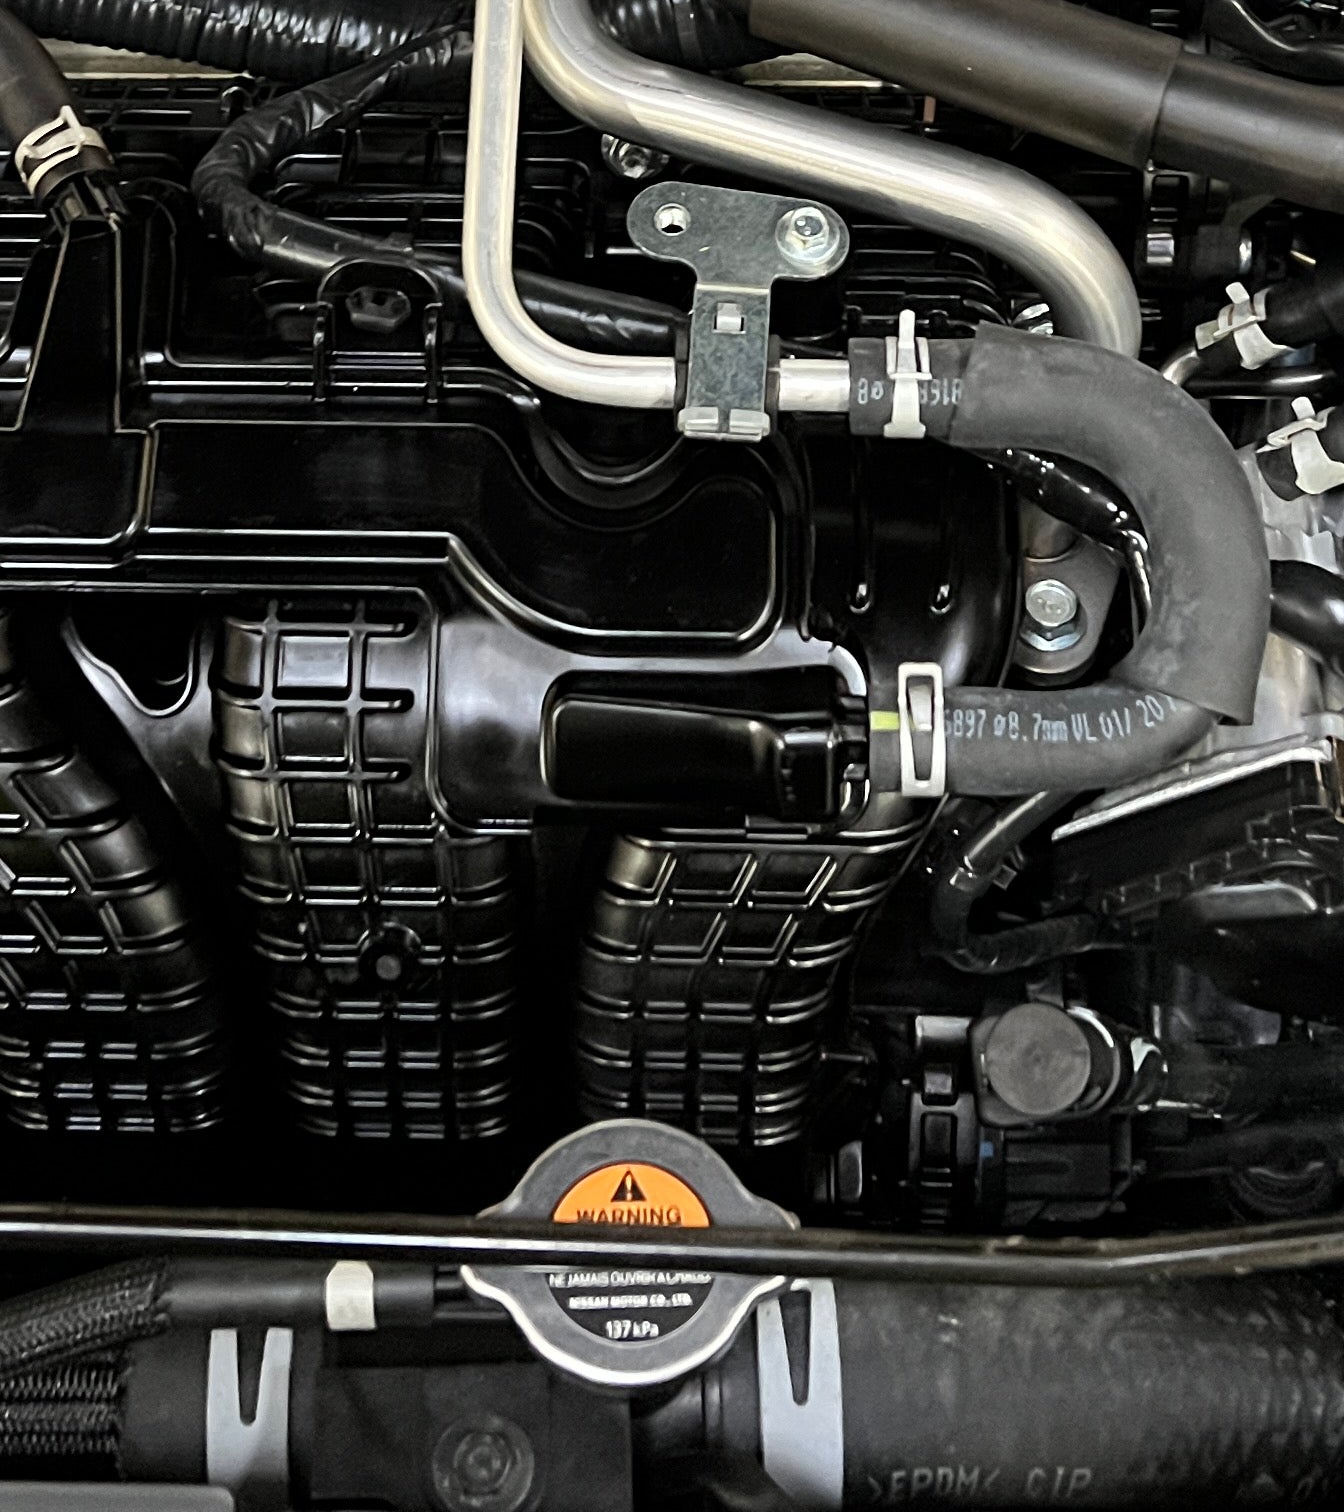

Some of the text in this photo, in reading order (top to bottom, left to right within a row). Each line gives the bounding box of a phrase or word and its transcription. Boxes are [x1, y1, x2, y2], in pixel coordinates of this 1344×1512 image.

[577, 1203, 682, 1227] WARNING
[568, 1272, 609, 1287] JAMAIS
[568, 1296, 608, 1309] NISSAN
[610, 1296, 648, 1308] MOTOR
[606, 1319, 632, 1339] 137
